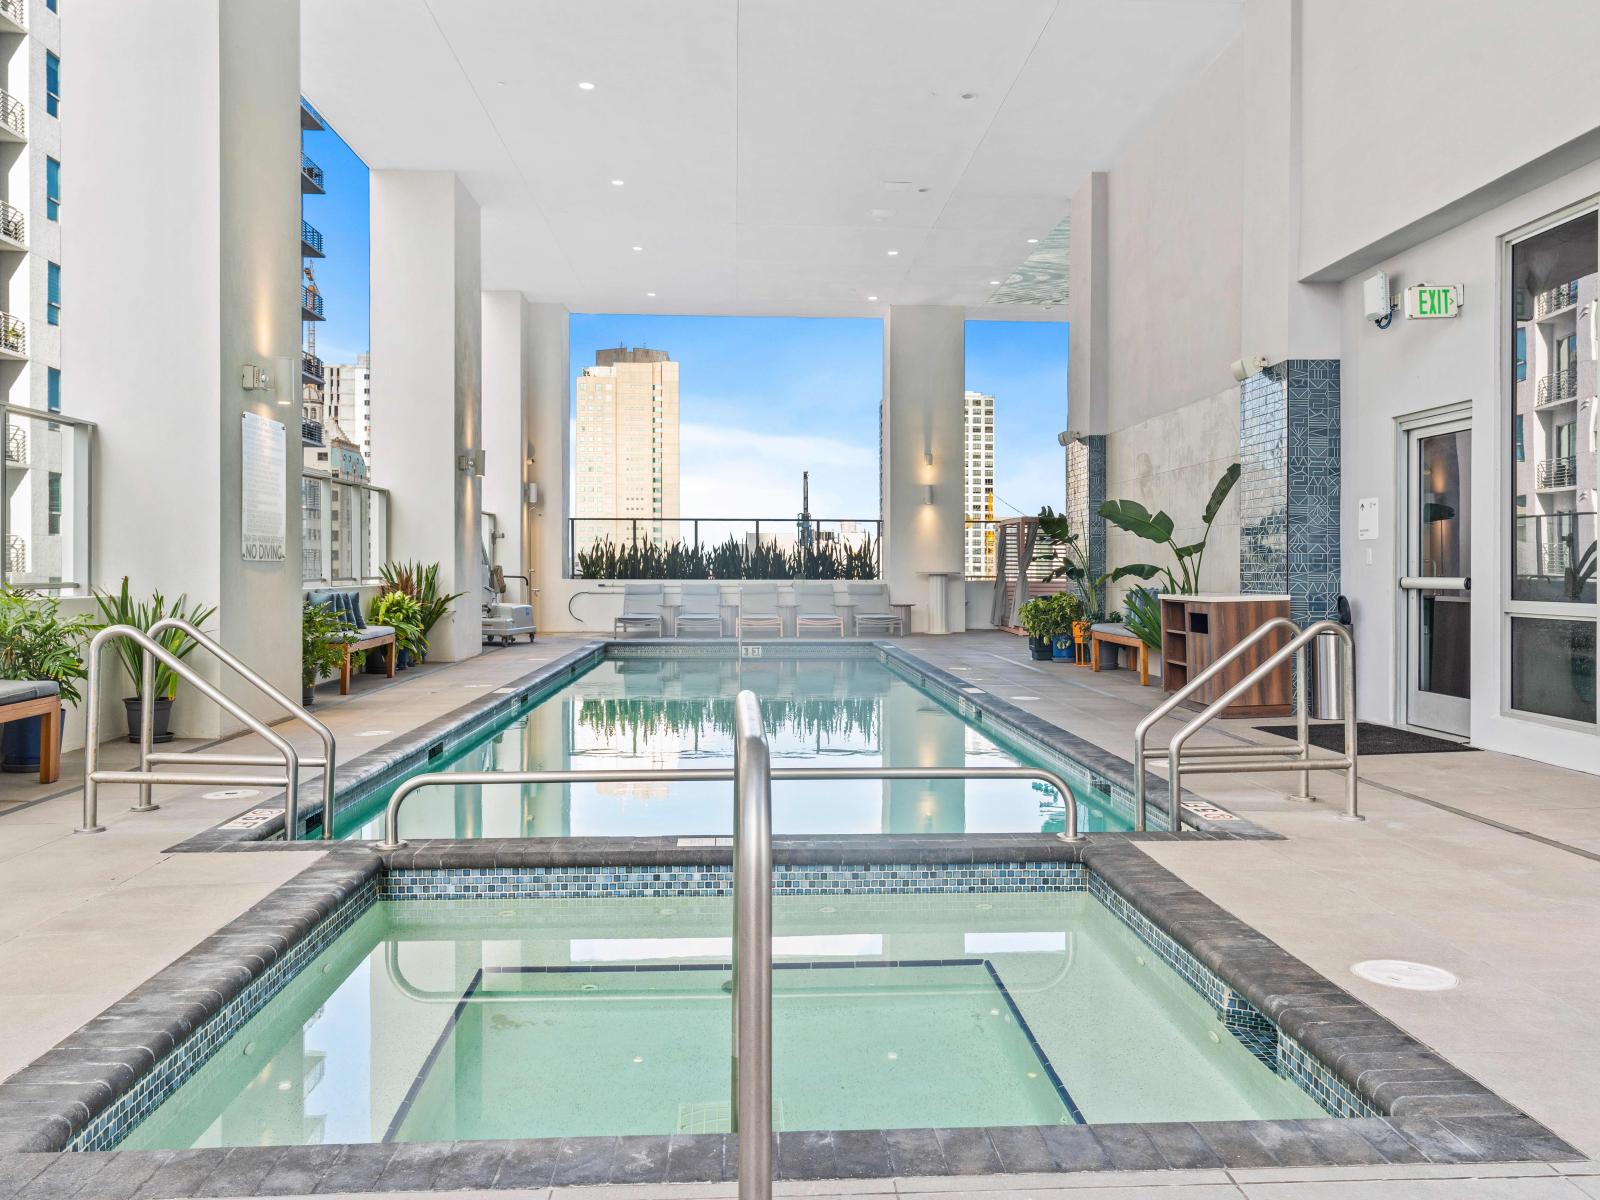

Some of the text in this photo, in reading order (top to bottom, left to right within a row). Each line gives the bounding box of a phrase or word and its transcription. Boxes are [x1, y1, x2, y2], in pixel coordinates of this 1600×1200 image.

[1418, 289, 1450, 314] EXIT
[245, 543, 283, 560] NO DIVING
